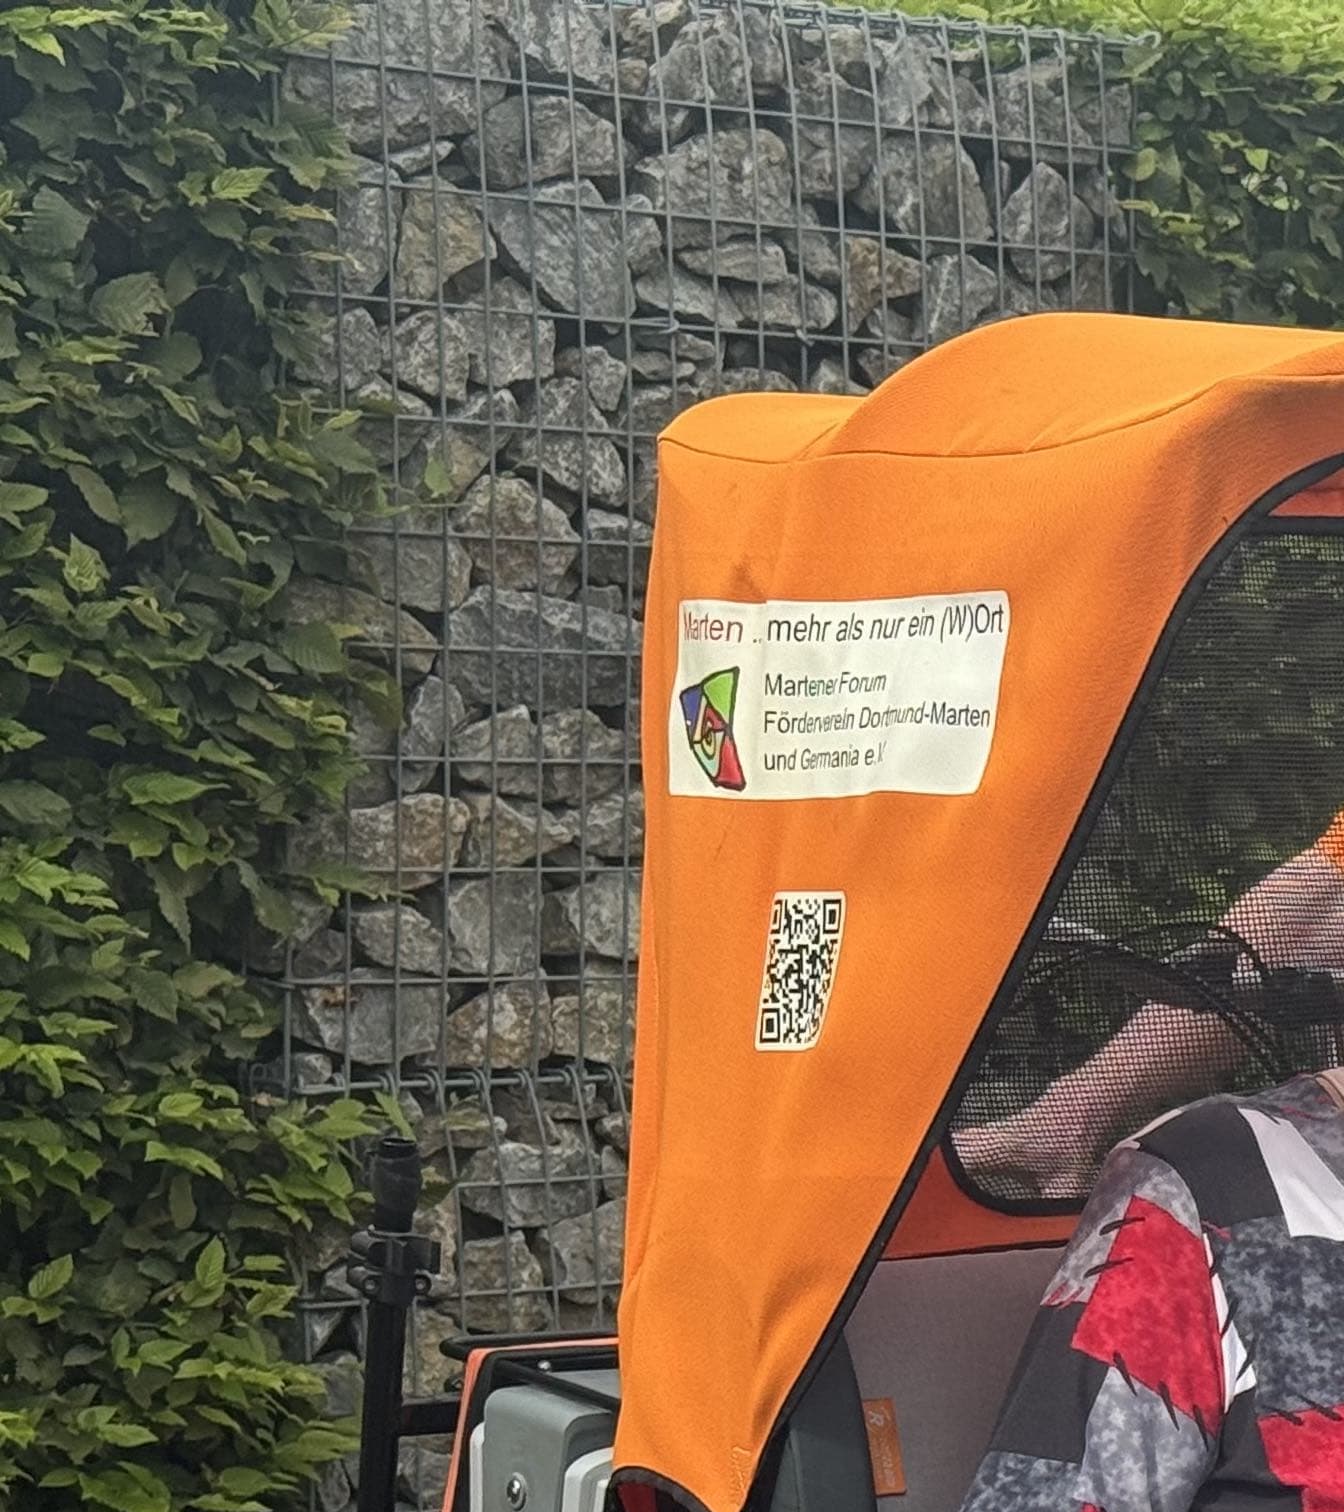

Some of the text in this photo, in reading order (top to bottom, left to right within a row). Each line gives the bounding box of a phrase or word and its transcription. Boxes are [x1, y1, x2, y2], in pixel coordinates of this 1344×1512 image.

[683, 611, 744, 644] Marten
[767, 613, 833, 643] mehr
[835, 612, 865, 642] als
[868, 616, 906, 640] nur
[907, 606, 935, 638] ein
[940, 603, 1004, 644] (W)Ort
[764, 671, 888, 698] Martener Forum
[858, 701, 991, 729] Dortmund-Marten
[763, 747, 798, 772] und
[800, 743, 860, 771] Germania
